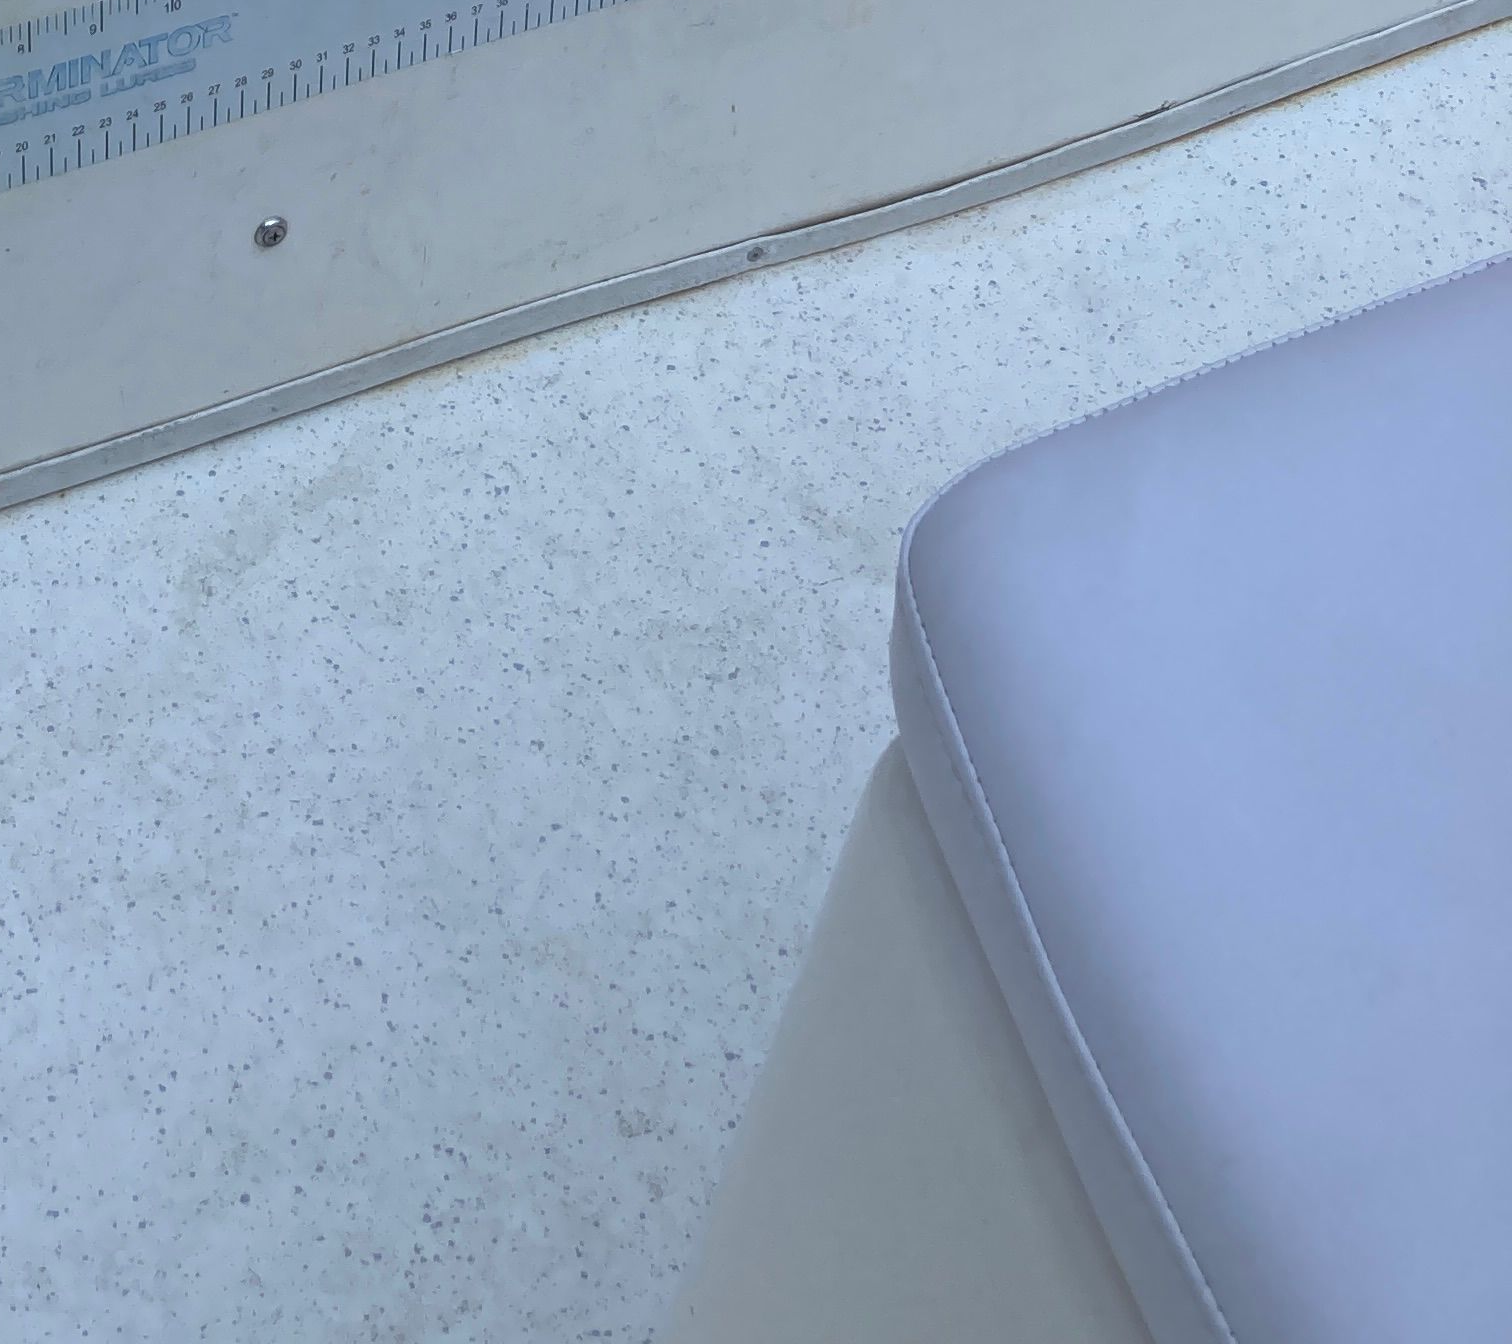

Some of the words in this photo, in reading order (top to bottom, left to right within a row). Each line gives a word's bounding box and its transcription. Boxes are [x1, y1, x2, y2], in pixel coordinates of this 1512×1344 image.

[89, 23, 97, 36] 9
[163, 0, 182, 14] 10
[15, 141, 29, 153] 20
[71, 124, 85, 137] 22
[126, 108, 139, 121] 24
[180, 92, 194, 104] 26
[234, 75, 248, 88] 28
[289, 59, 302, 71] 30
[342, 42, 355, 55] 32
[394, 27, 405, 39] 34
[445, 11, 457, 23] 36
